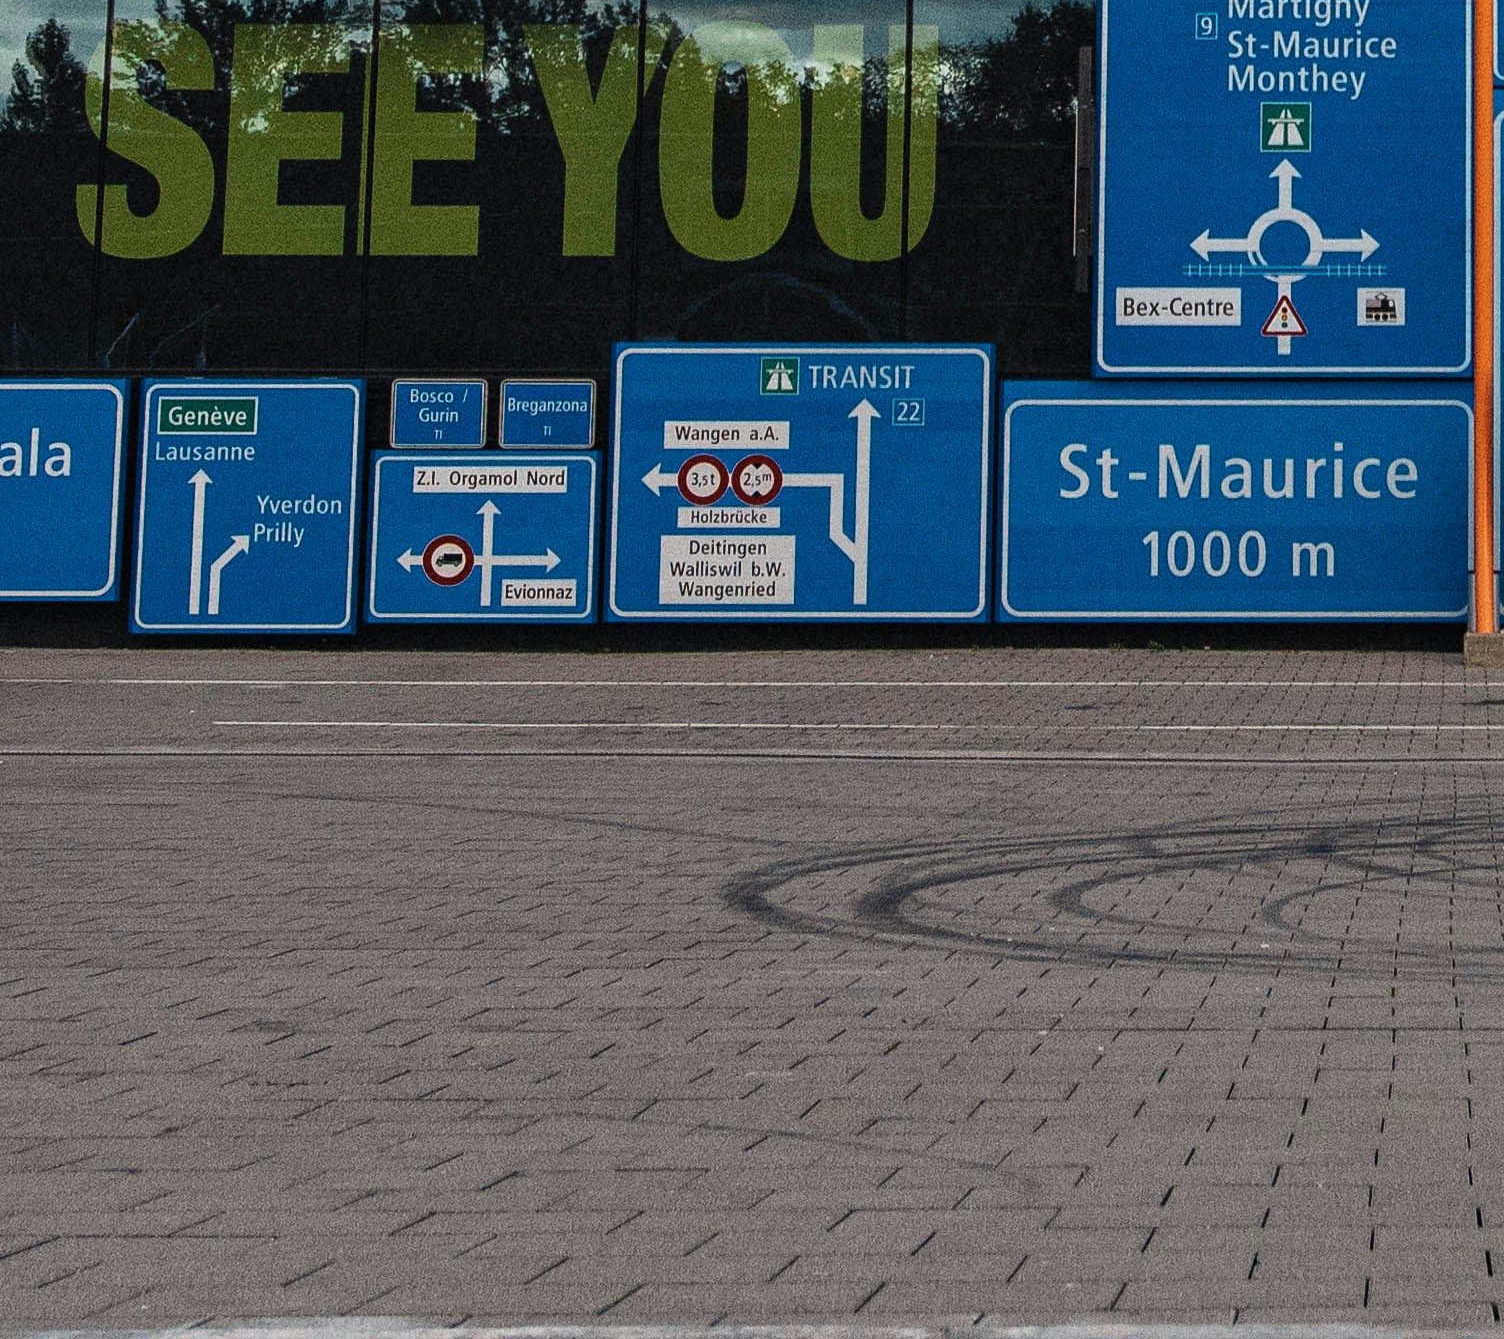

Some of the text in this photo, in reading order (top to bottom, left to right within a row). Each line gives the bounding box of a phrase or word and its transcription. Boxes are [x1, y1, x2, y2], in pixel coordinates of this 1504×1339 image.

[1228, 62, 1366, 101] Monthey
[76, 21, 940, 262] SEE YOU
[1123, 296, 1234, 317] Bex-Centre
[507, 397, 588, 417] Breganzona
[897, 401, 920, 422] 22
[675, 425, 779, 445] Wangen a.A.
[256, 493, 342, 515] Yverdon
[1142, 530, 1335, 577] 1000 m
[505, 583, 573, 600] Evionnaz
[678, 580, 776, 601] Wangenried
